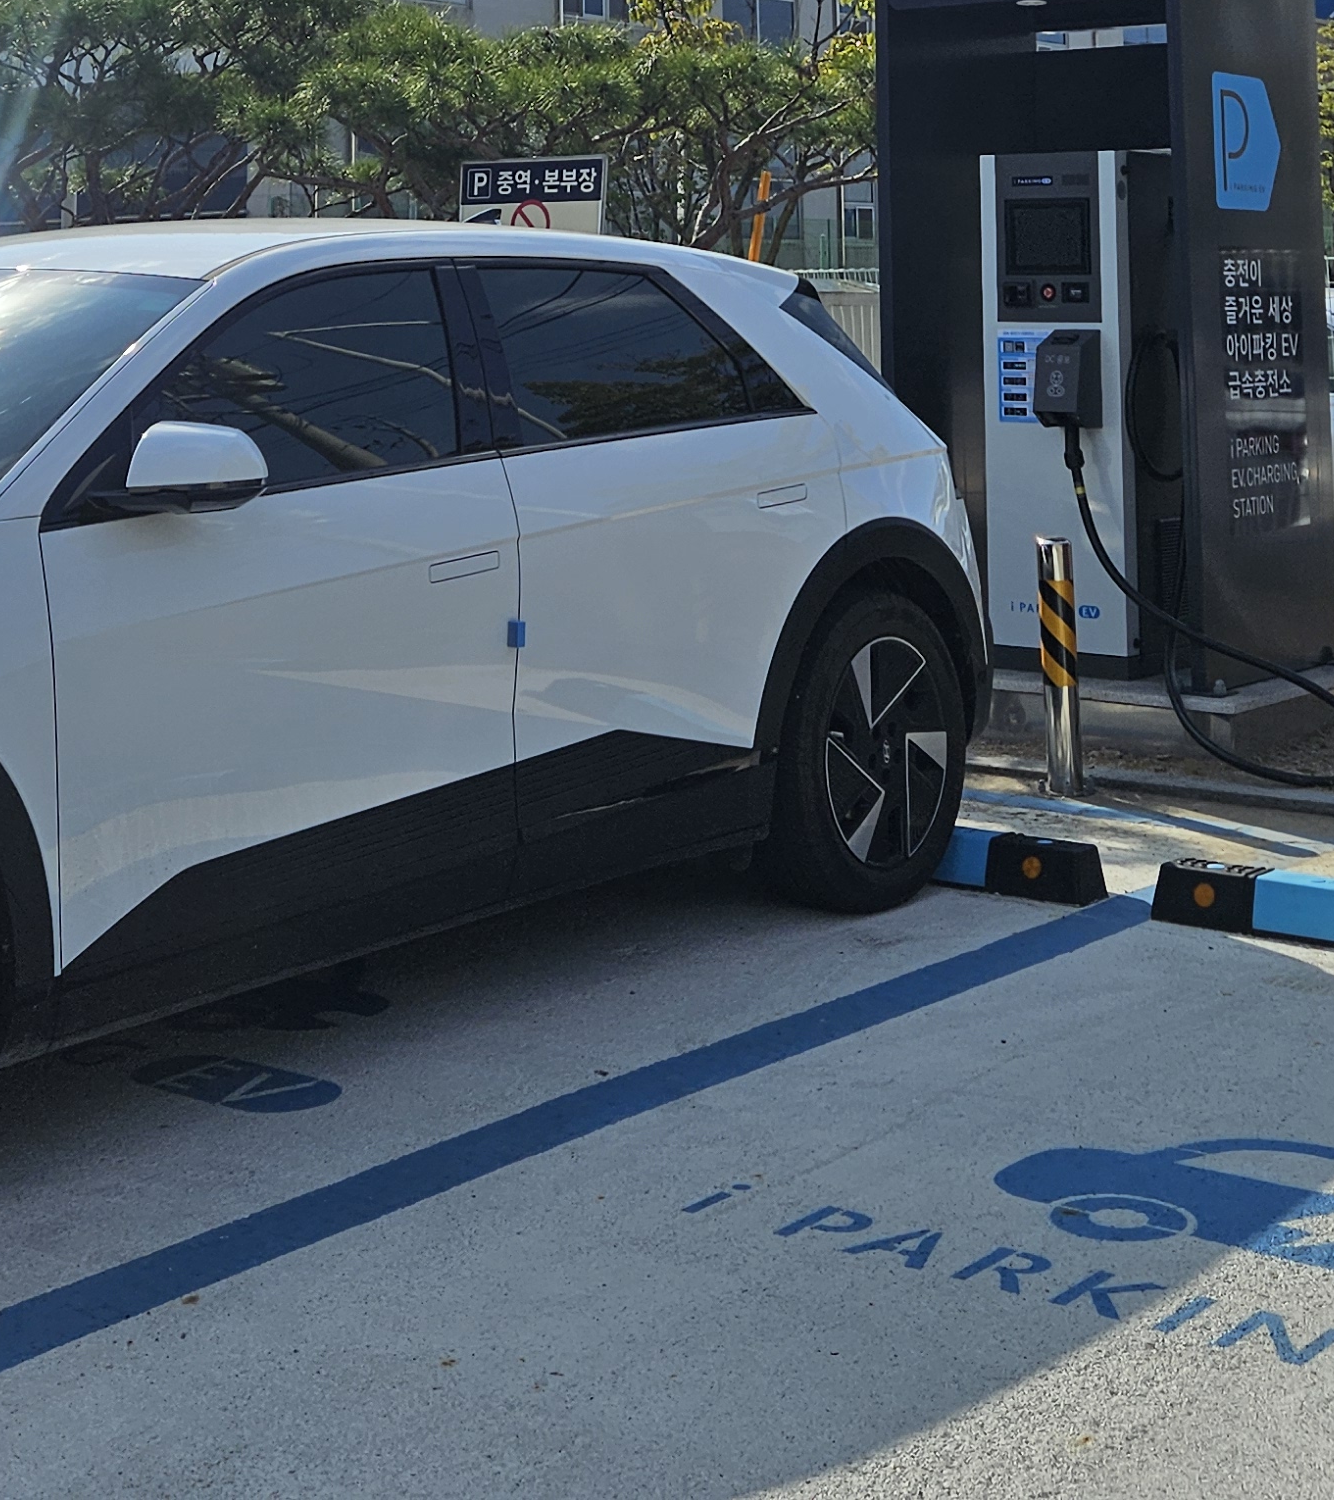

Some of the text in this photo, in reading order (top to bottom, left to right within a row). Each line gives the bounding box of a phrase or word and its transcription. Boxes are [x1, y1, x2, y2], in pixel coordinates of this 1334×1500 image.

[473, 172, 488, 196] P
[1223, 258, 1262, 288] 충전이
[1224, 295, 1293, 325] 즐거운 세상
[1226, 332, 1299, 362] 아이파킹 EV
[1228, 368, 1292, 400] 급속충전소
[1236, 434, 1280, 457] PARKING
[1232, 494, 1274, 519] STATION
[1082, 607, 1097, 618] EV
[153, 1056, 323, 1103] EV
